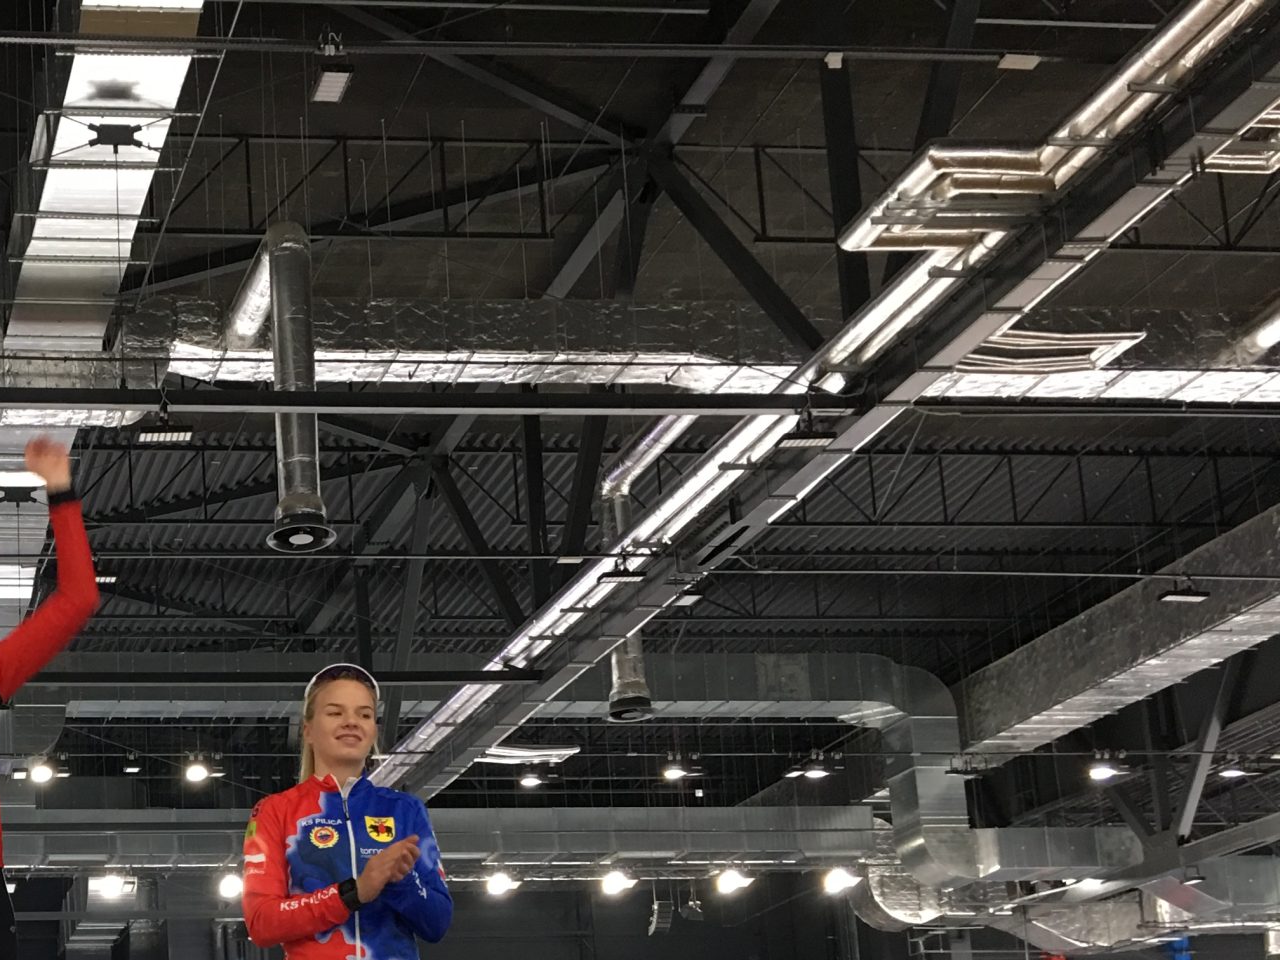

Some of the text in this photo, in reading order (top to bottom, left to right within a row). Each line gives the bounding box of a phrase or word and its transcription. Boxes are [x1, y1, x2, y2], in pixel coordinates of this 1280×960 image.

[302, 818, 342, 827] KS PILICA
[280, 887, 338, 911] KS PILICA
